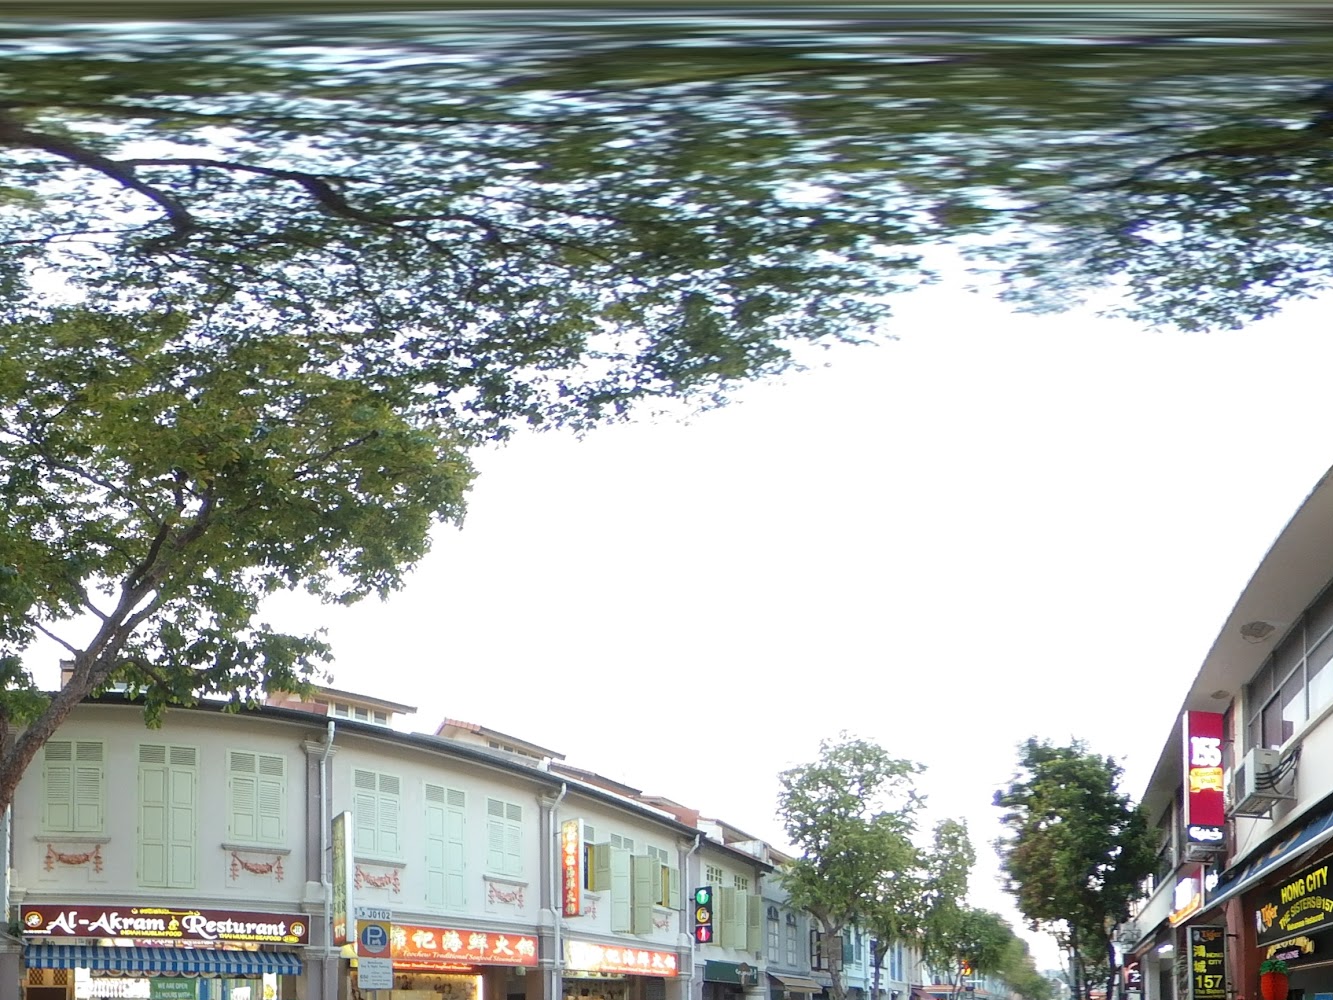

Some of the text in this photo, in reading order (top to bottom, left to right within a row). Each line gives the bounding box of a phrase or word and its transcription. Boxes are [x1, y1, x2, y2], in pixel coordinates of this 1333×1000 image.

[1190, 736, 1222, 767] 155
[1281, 865, 1328, 905] HONG CITY
[182, 914, 287, 940] Resturant
[1195, 975, 1223, 989] 157
